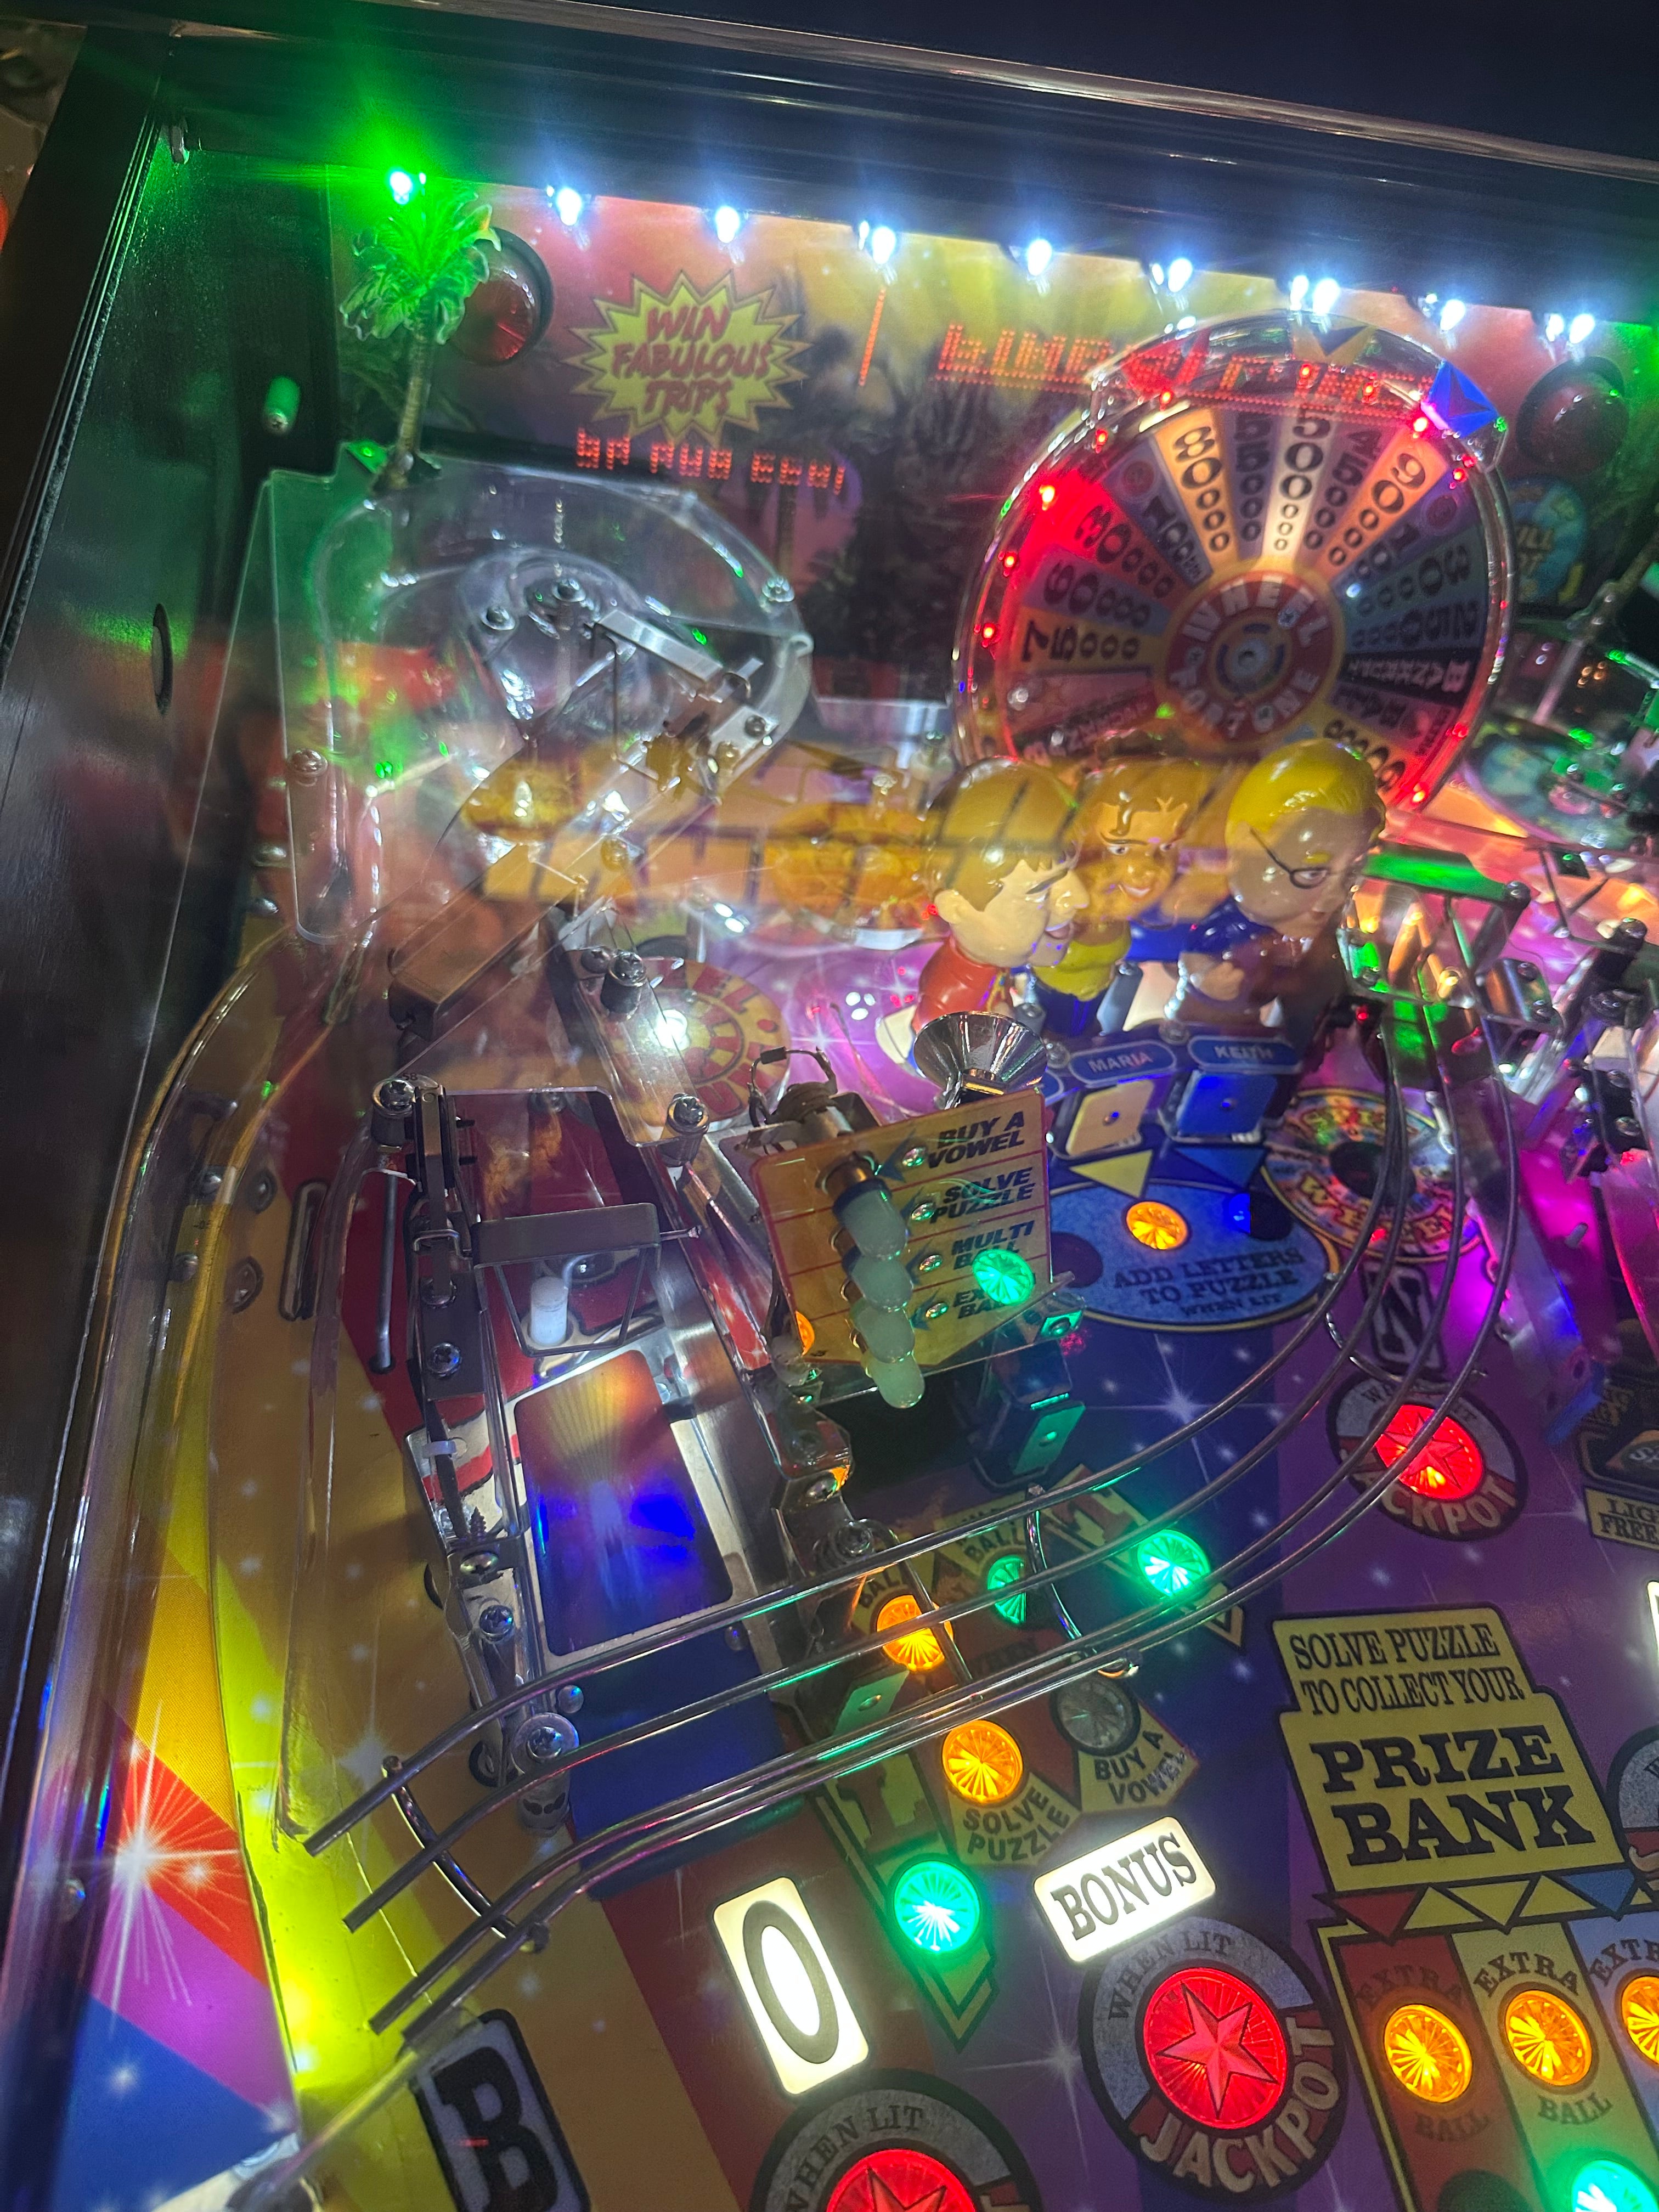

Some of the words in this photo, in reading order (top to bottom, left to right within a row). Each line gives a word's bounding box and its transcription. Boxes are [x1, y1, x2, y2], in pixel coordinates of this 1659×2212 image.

[646, 305, 731, 343] WIN
[612, 340, 773, 380] FABULOUS
[643, 378, 733, 415] TRIPS
[1172, 426, 1230, 551] 80000
[1088, 1051, 1154, 1073] MARIA
[1214, 1045, 1274, 1059] KEITH
[928, 1130, 1025, 1168] VOWEL
[938, 1116, 1001, 1149] BUY
[1003, 1111, 1025, 1132] A
[929, 1182, 1036, 1223] PUZZLE
[943, 1167, 1033, 1204] SOLVE
[951, 1220, 1035, 1256] MULTI
[1114, 1266, 1174, 1288] ADD
[1181, 1248, 1305, 1278] LETTERS
[1139, 1285, 1182, 1305] TO
[1187, 1269, 1299, 1299] PUZZLE
[1180, 1299, 1243, 1316] WHEN
[1249, 1294, 1282, 1306] LIT
[1289, 1630, 1388, 1670] SOLVE
[1385, 1622, 1501, 1664] PUZZLE
[1301, 1679, 1340, 1716] TO
[1340, 1671, 1454, 1713] COLLECT
[1452, 1666, 1526, 1705] YOUR
[1094, 1746, 1149, 1782] BUY
[1142, 1729, 1164, 1750] A
[1310, 1724, 1564, 1793] PRIZE
[962, 1786, 1048, 1835] SOLVE
[1331, 1785, 1596, 1866] BANK
[967, 1809, 1071, 1863] PUZZLE
[1049, 1832, 1198, 1942] BONUS
[1107, 1937, 1175, 2021] WHEN
[1183, 1929, 1234, 1956] LIT
[1473, 1951, 1580, 1998] EXTRA
[1588, 1938, 1659, 1988] EXTR
[1355, 1964, 1466, 2007] EXTRA
[867, 2104, 926, 2132] LIT
[1139, 2016, 1340, 2194] JACKPOT
[1537, 2091, 1614, 2125] BALL
[433, 2046, 558, 2212] B
[1414, 2110, 1489, 2142] BALL
